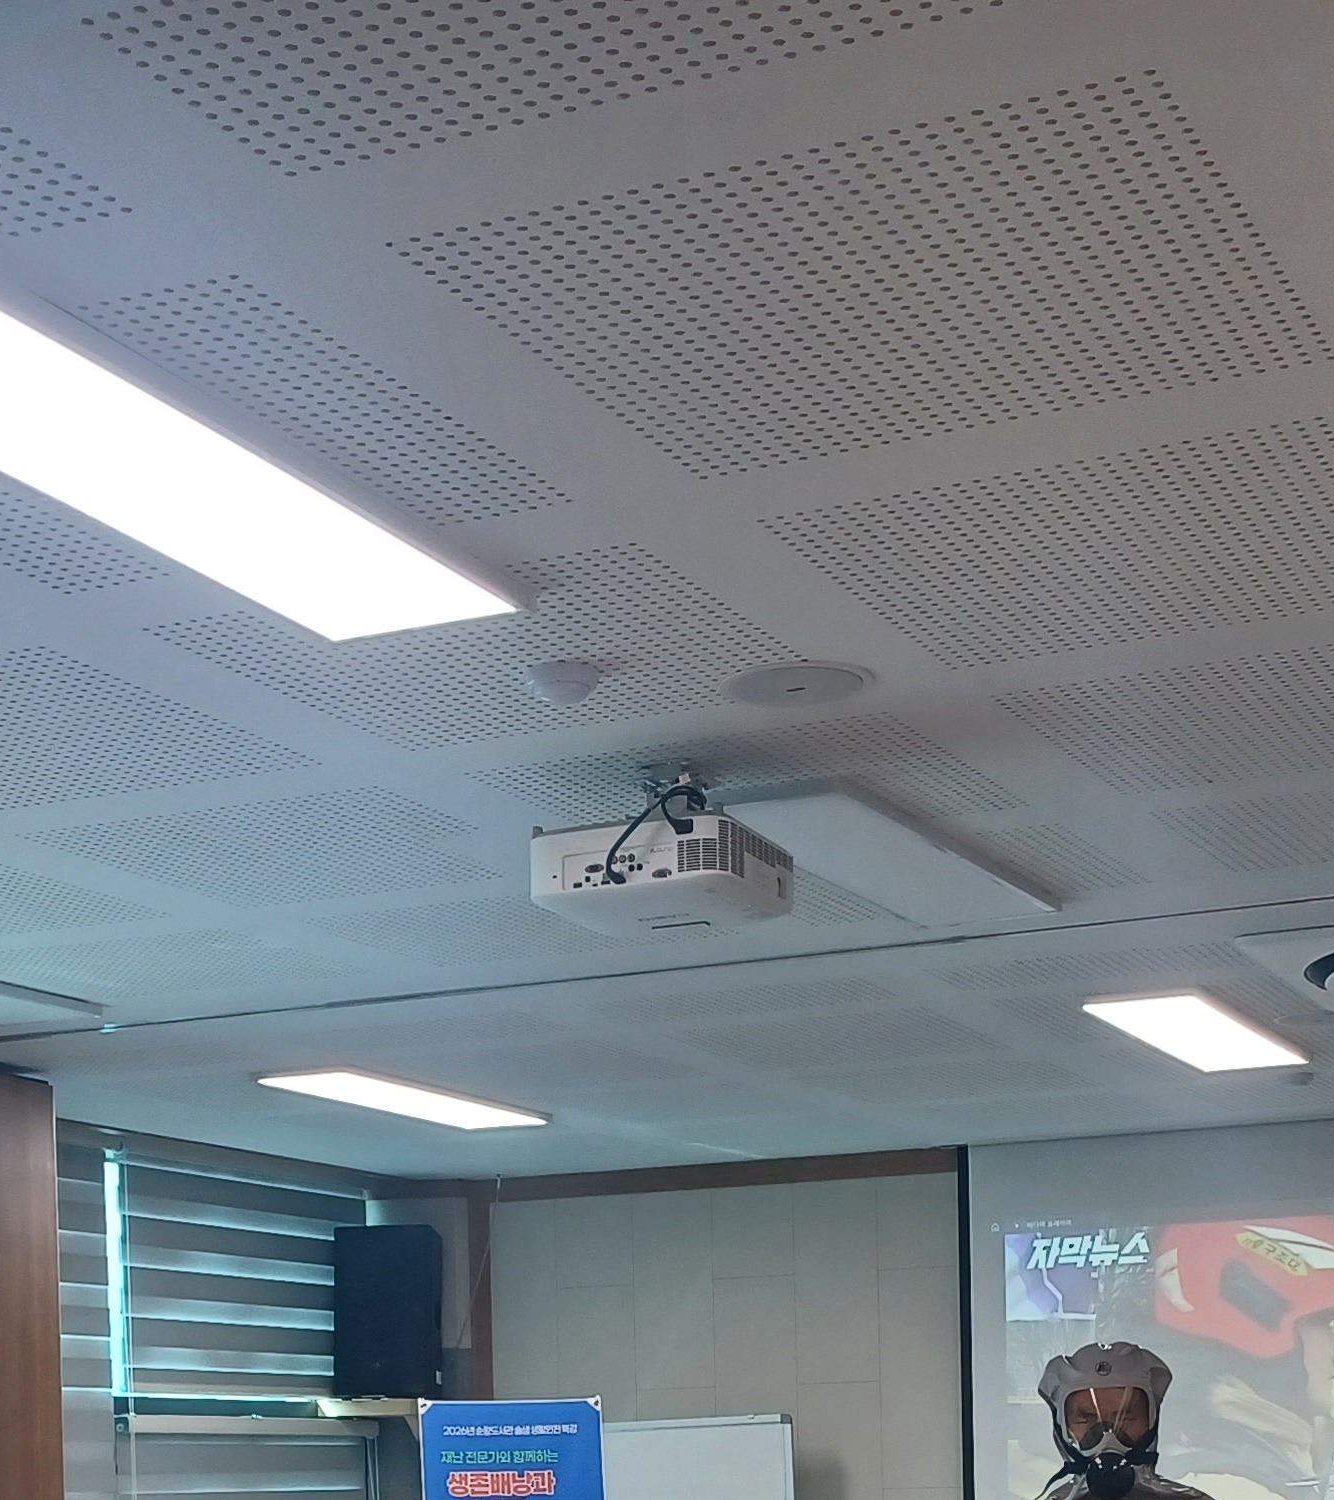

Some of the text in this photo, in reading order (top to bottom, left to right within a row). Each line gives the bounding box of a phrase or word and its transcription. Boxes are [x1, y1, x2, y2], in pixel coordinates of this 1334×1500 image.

[1027, 1231, 1151, 1270] 자막뉴스
[441, 1449, 559, 1464] 재난 전문가와 함께하는
[447, 1470, 556, 1497] 생존배낭과
